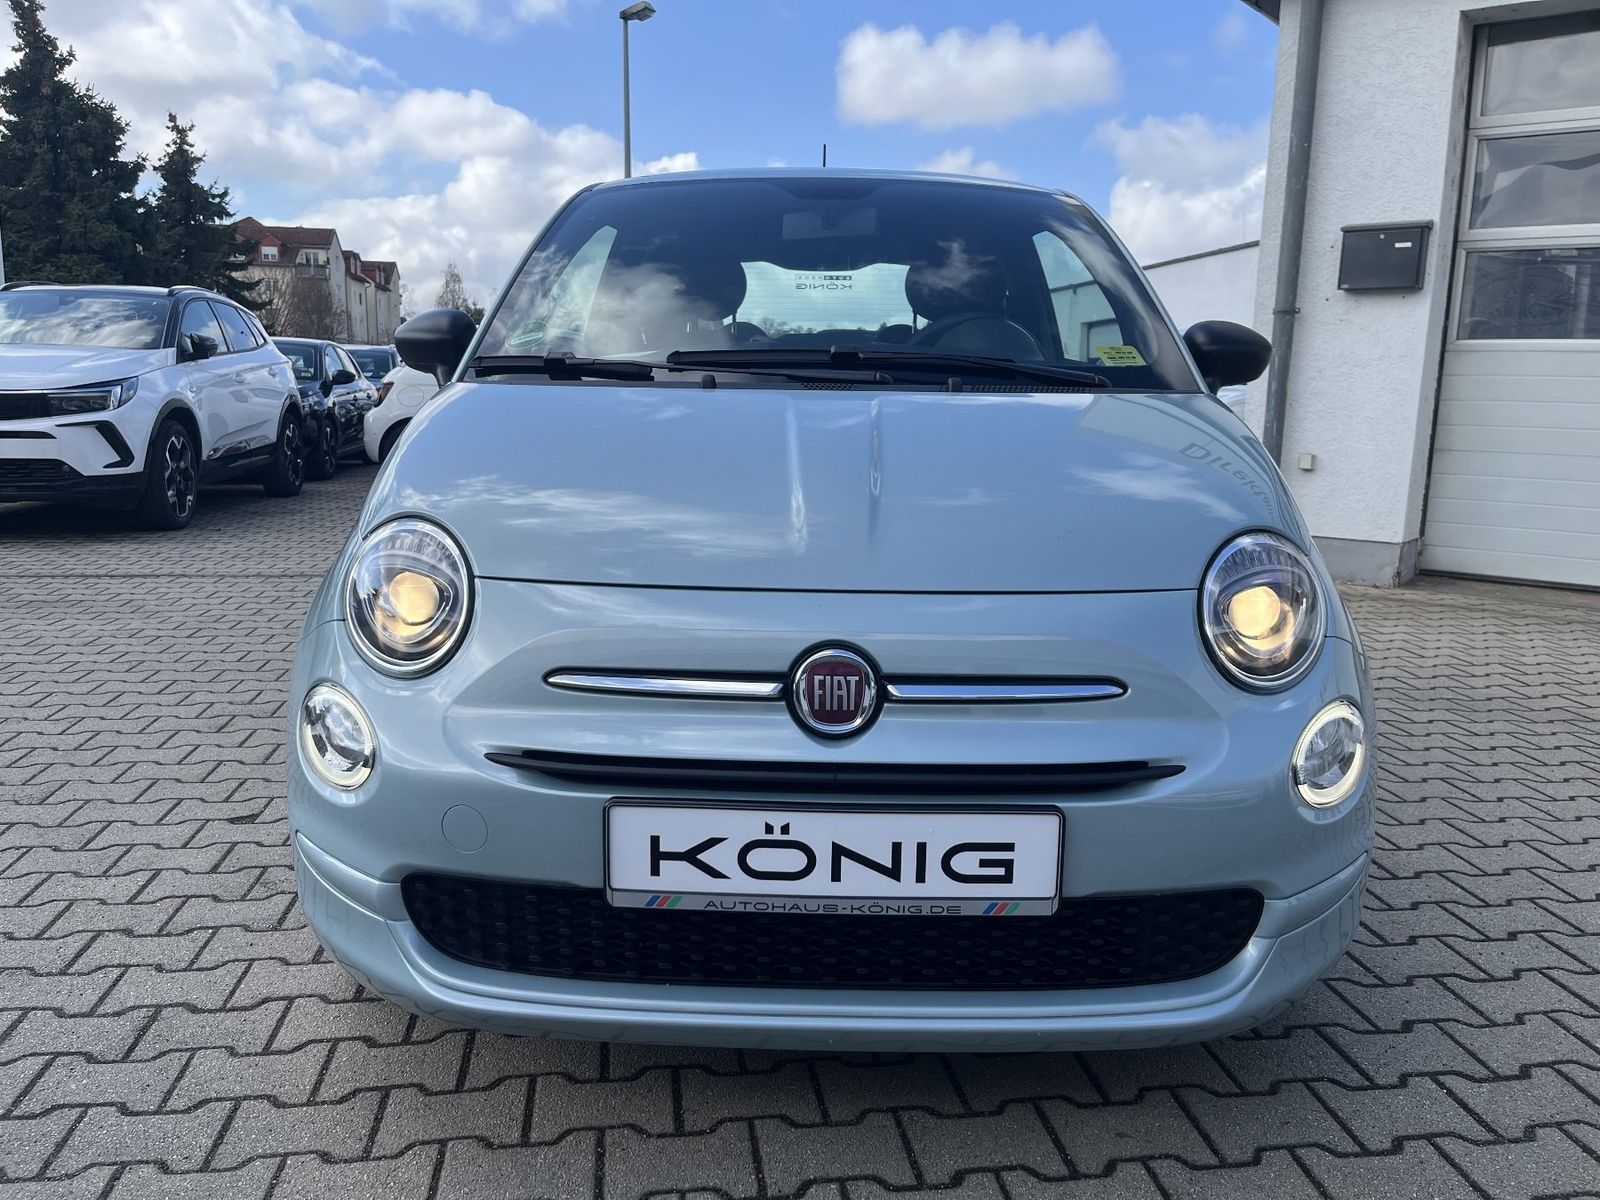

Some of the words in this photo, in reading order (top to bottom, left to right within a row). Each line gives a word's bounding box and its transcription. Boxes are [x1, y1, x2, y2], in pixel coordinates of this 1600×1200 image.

[813, 675, 859, 711] FIAT
[649, 820, 1016, 885] KÖNIG
[704, 900, 962, 915] AUTOHAUS-KÖNIG.DE
